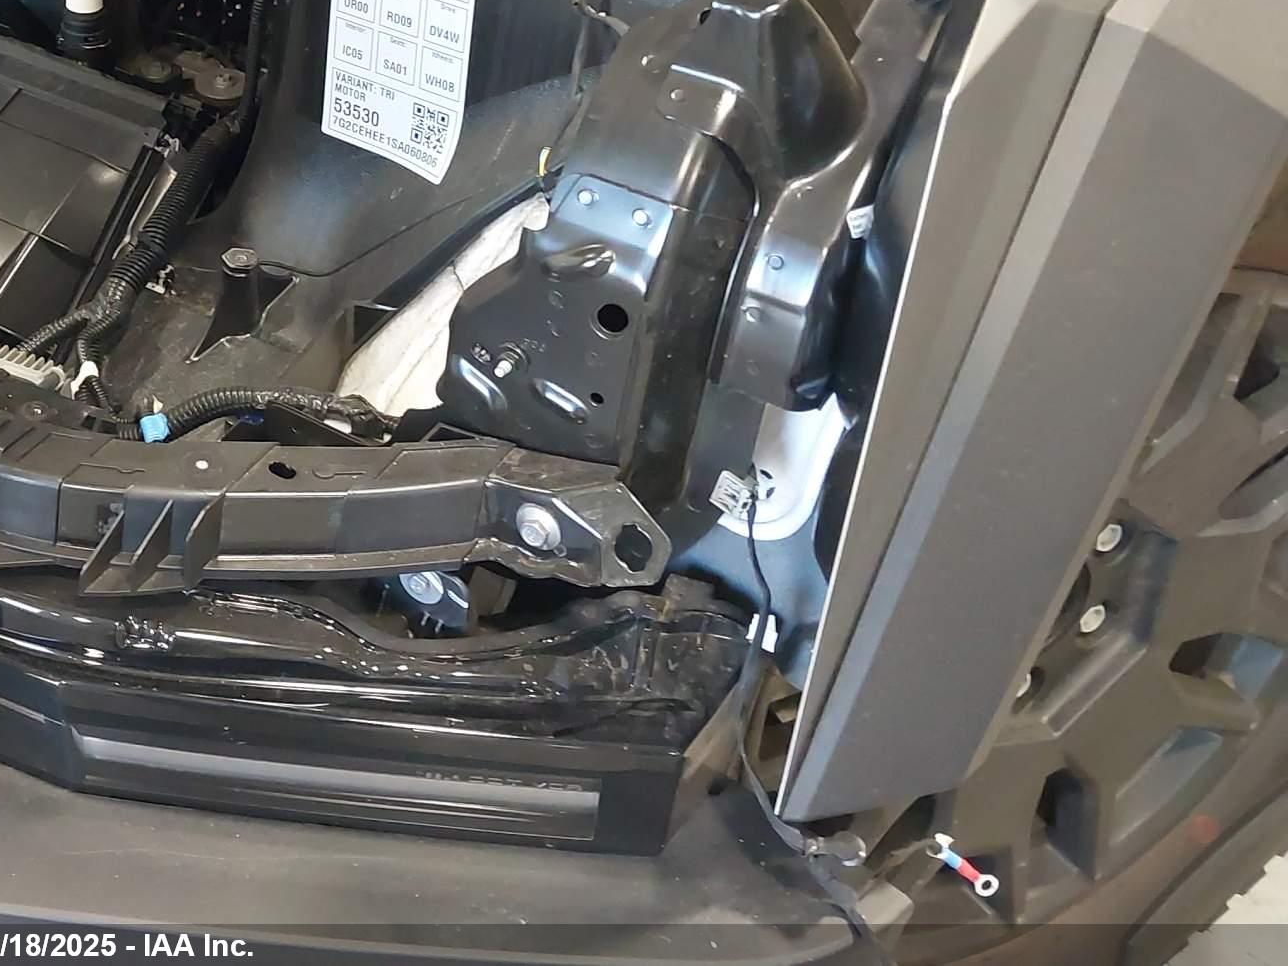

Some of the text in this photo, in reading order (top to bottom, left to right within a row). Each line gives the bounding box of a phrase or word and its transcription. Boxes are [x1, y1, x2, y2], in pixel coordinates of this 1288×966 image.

[386, 11, 413, 28] RD09
[429, 25, 460, 44] DV4W
[342, 44, 363, 60] IC05
[383, 59, 408, 76] SA01
[334, 83, 366, 102] MOTOR
[335, 71, 395, 101] VARIANT: TRI
[333, 97, 380, 127] 53530
